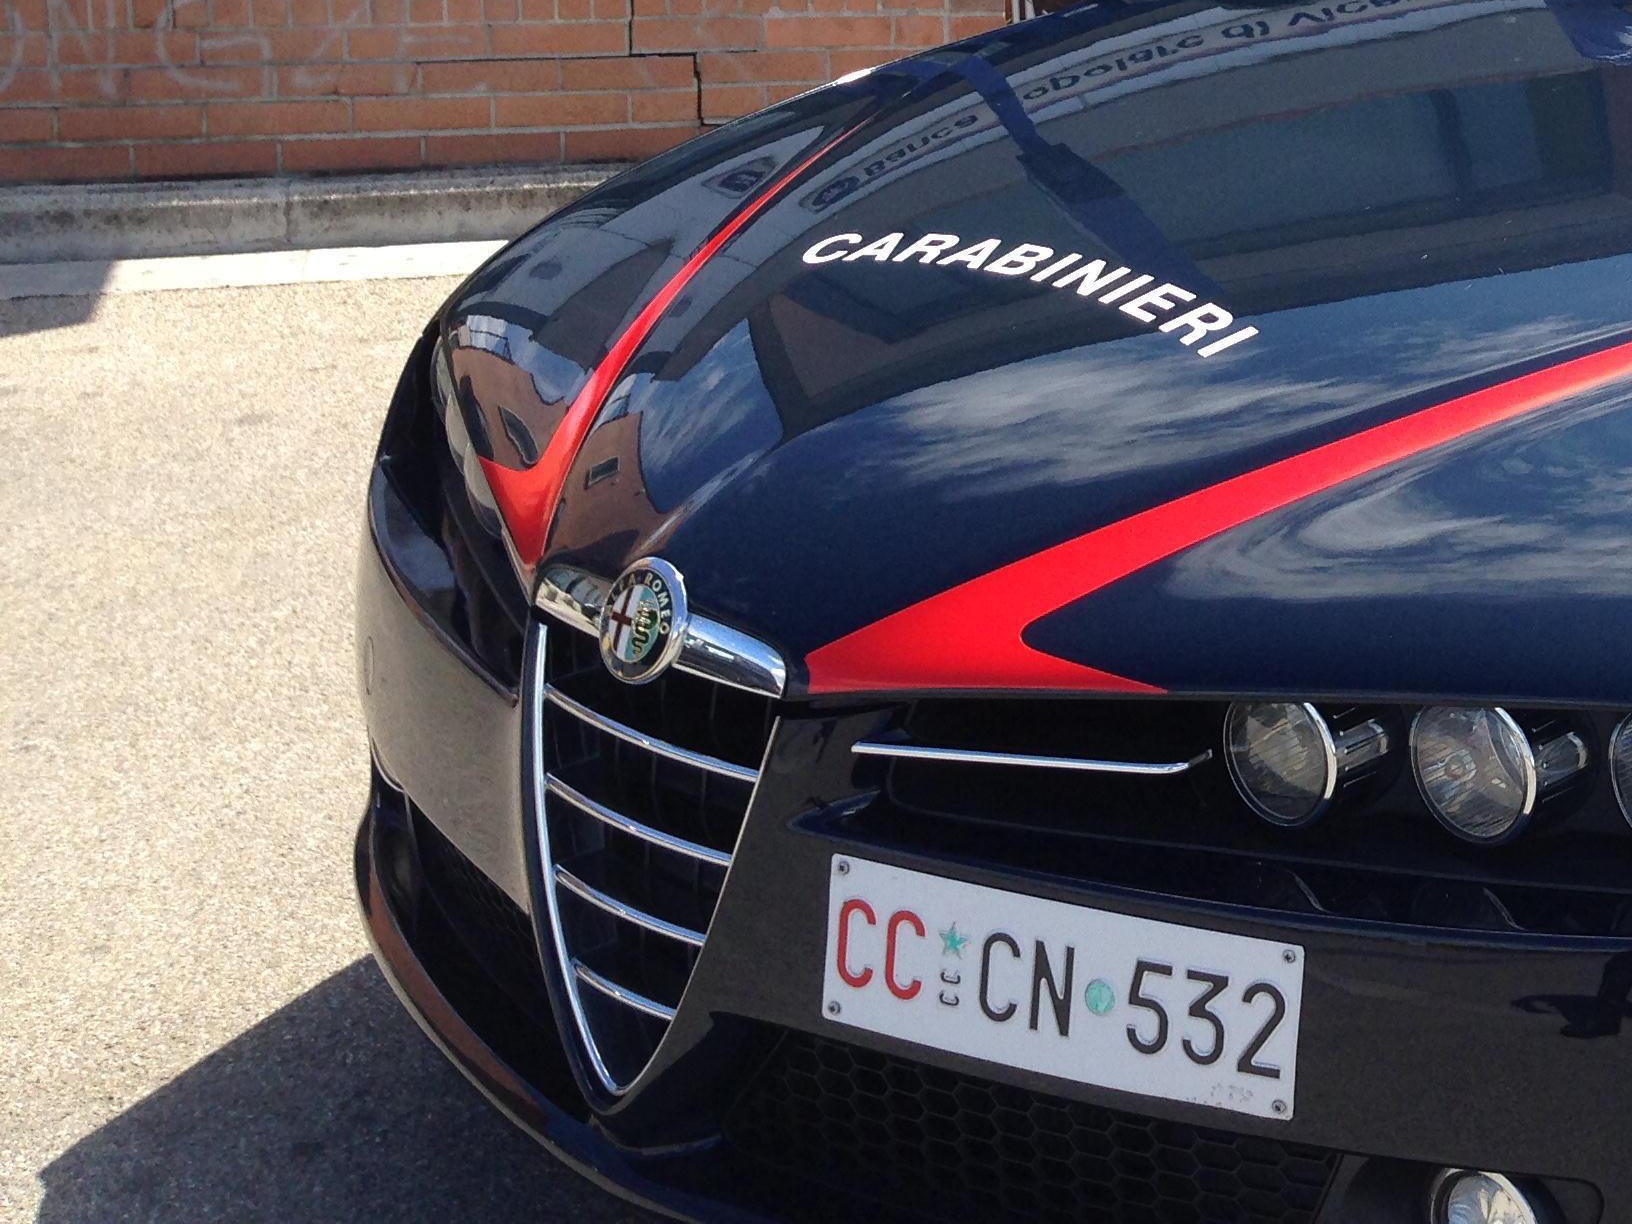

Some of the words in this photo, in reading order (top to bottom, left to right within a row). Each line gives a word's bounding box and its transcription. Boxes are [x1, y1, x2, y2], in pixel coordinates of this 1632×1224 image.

[800, 231, 1260, 359] CARABINIERI
[645, 572, 673, 635] ROMEO
[836, 898, 926, 1000] CC
[978, 931, 1076, 1039] CN
[1125, 958, 1288, 1080] 532
